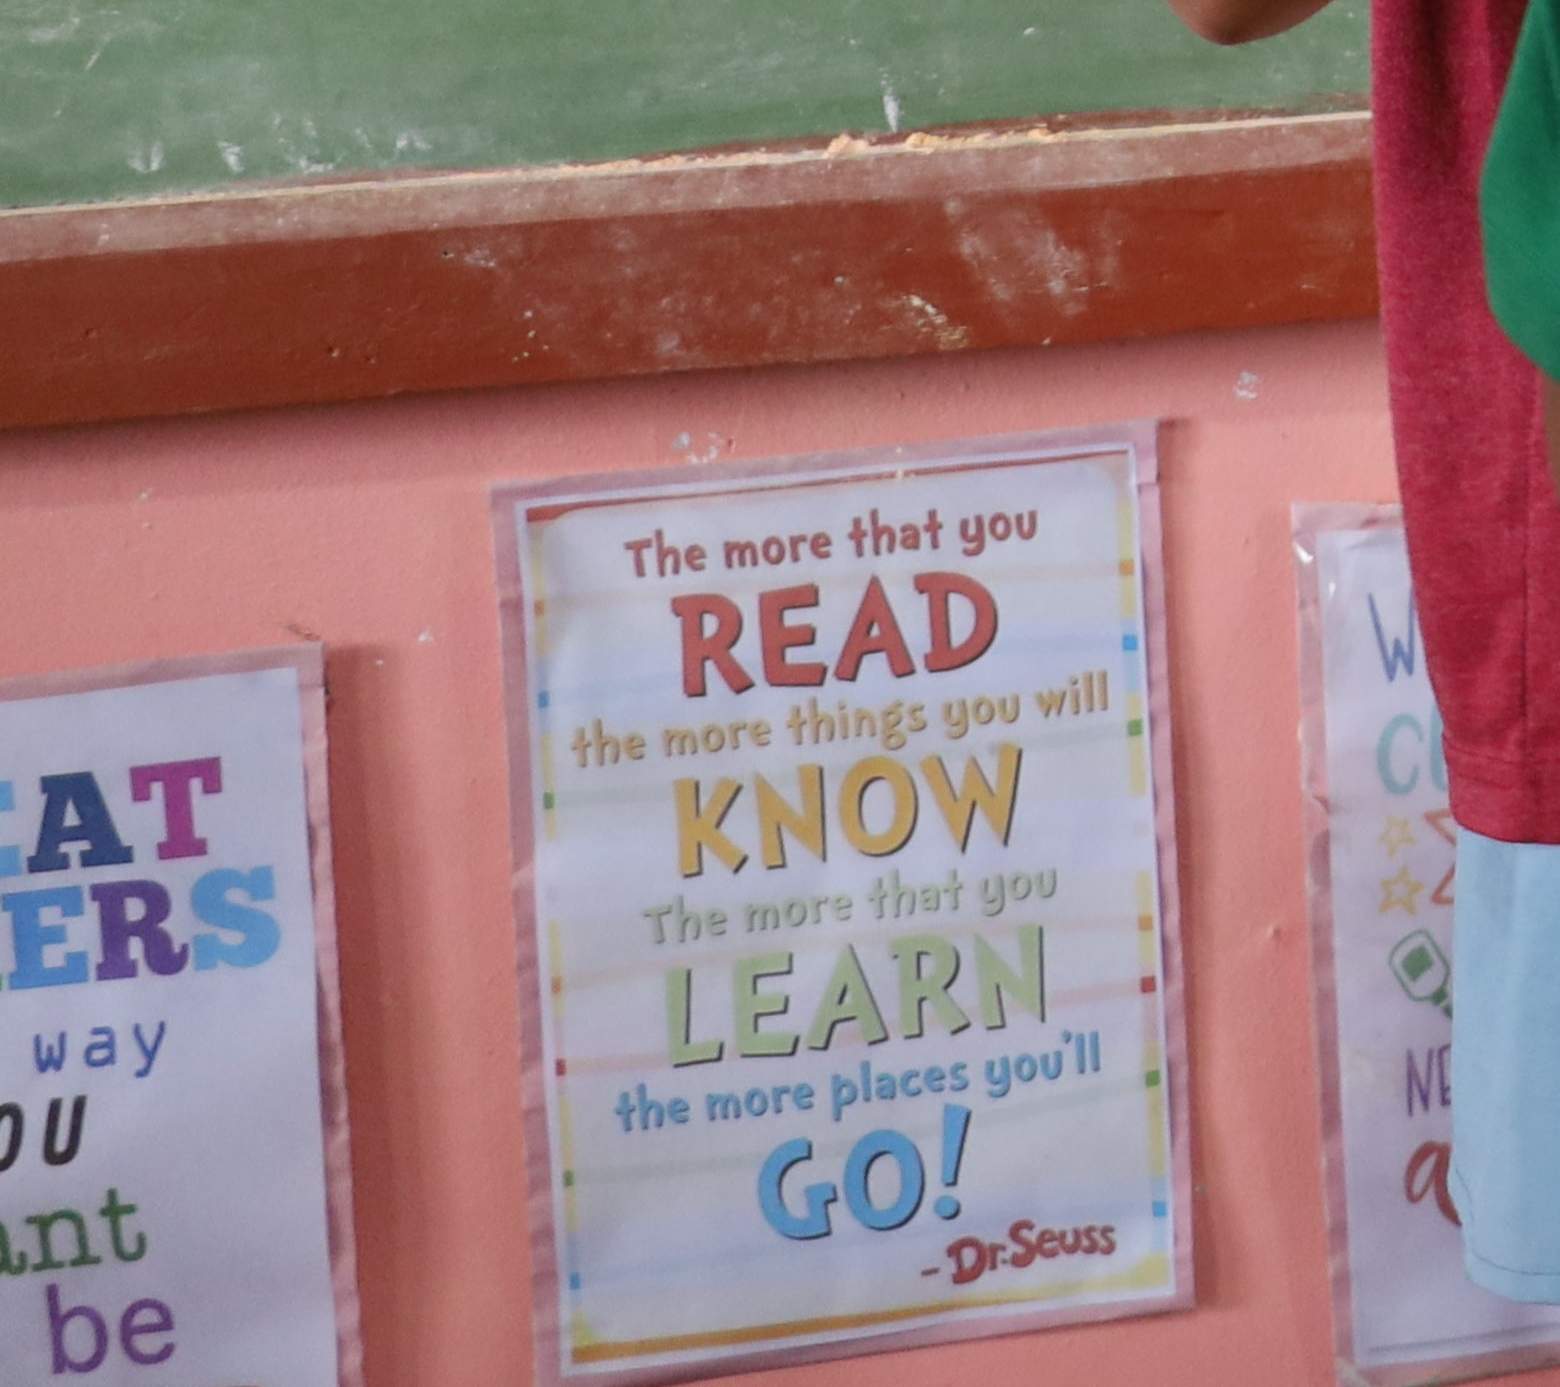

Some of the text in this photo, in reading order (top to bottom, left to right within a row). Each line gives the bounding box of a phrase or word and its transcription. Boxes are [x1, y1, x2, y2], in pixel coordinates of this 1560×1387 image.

[622, 506, 1040, 578] The more that you
[671, 570, 1000, 699] READ
[569, 670, 1111, 770] the more things you will
[0, 757, 222, 877] AT
[671, 741, 1025, 880] KNOW
[642, 866, 1060, 947] The more that you
[664, 922, 1048, 1069] LEARN
[33, 1020, 167, 1077] way
[613, 1031, 1104, 1135] the more places you'll
[755, 1103, 974, 1243] GO!
[45, 1284, 177, 1376] be
